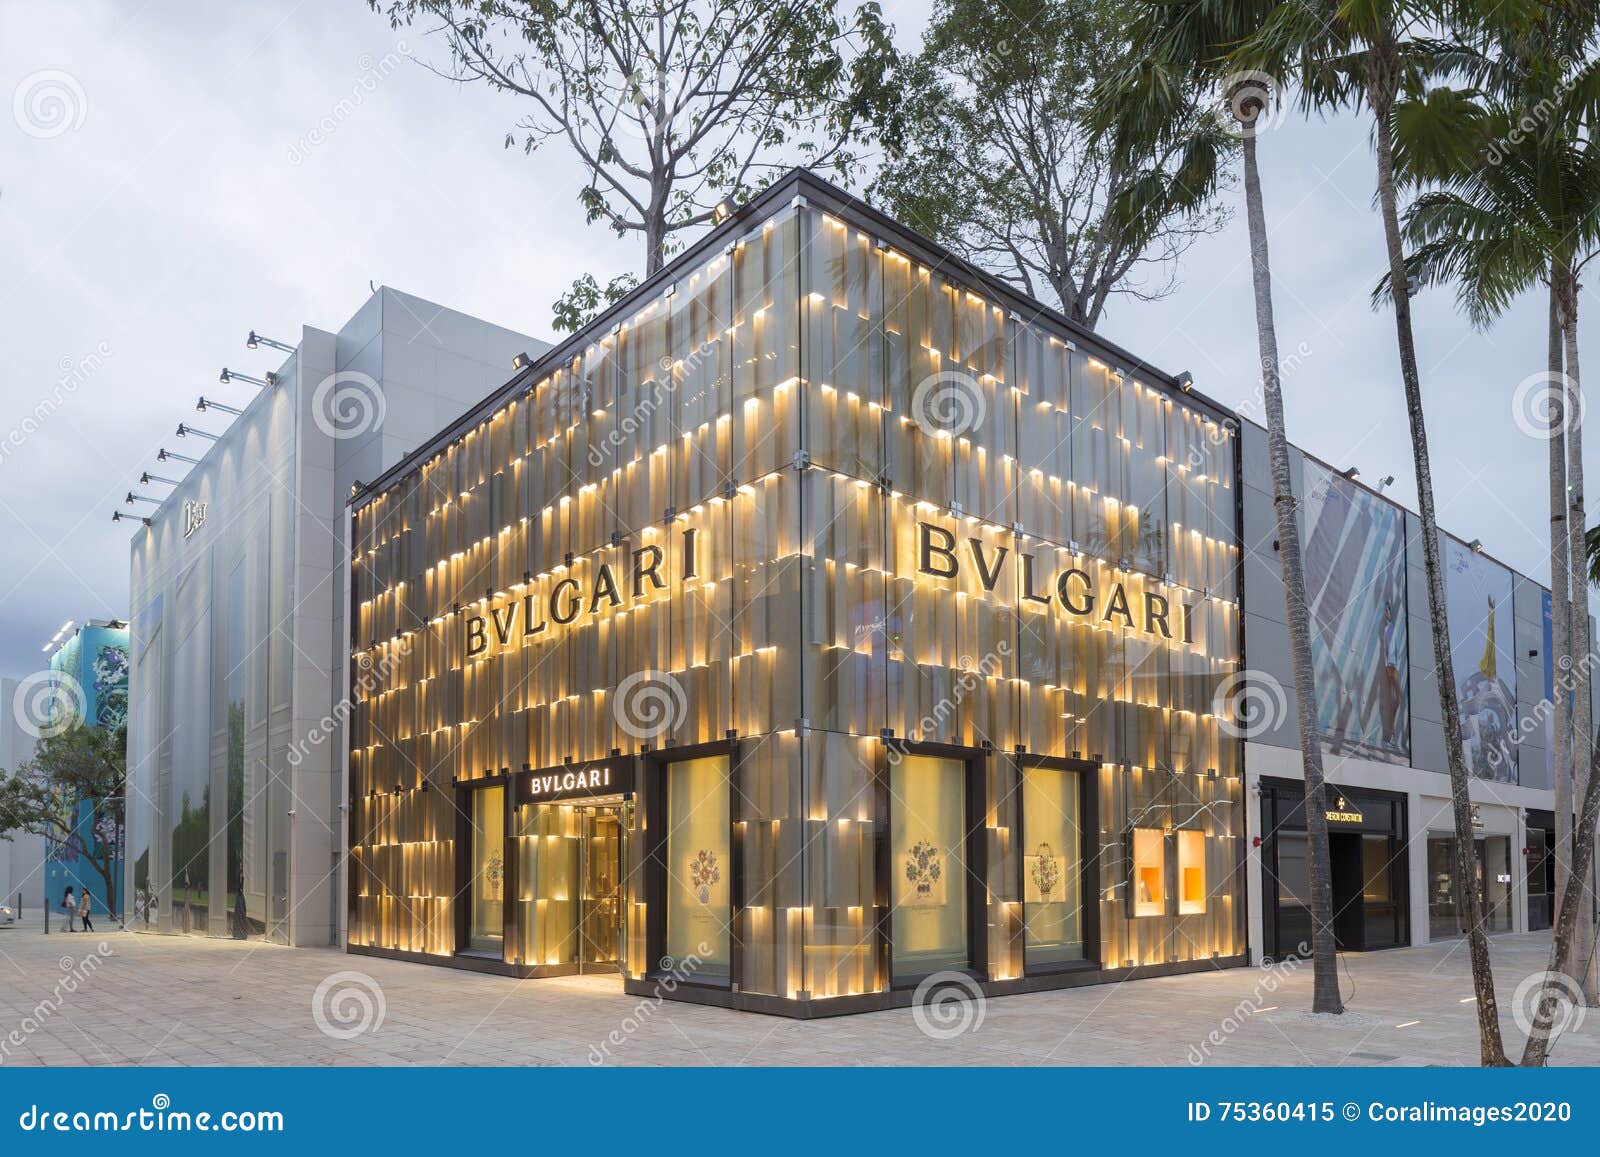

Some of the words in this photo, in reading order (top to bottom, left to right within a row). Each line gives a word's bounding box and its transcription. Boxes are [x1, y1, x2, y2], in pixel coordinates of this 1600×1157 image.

[466, 528, 698, 657] BVLGARI
[918, 521, 1195, 644] BVLGARI
[531, 768, 609, 794] BVLGARI
